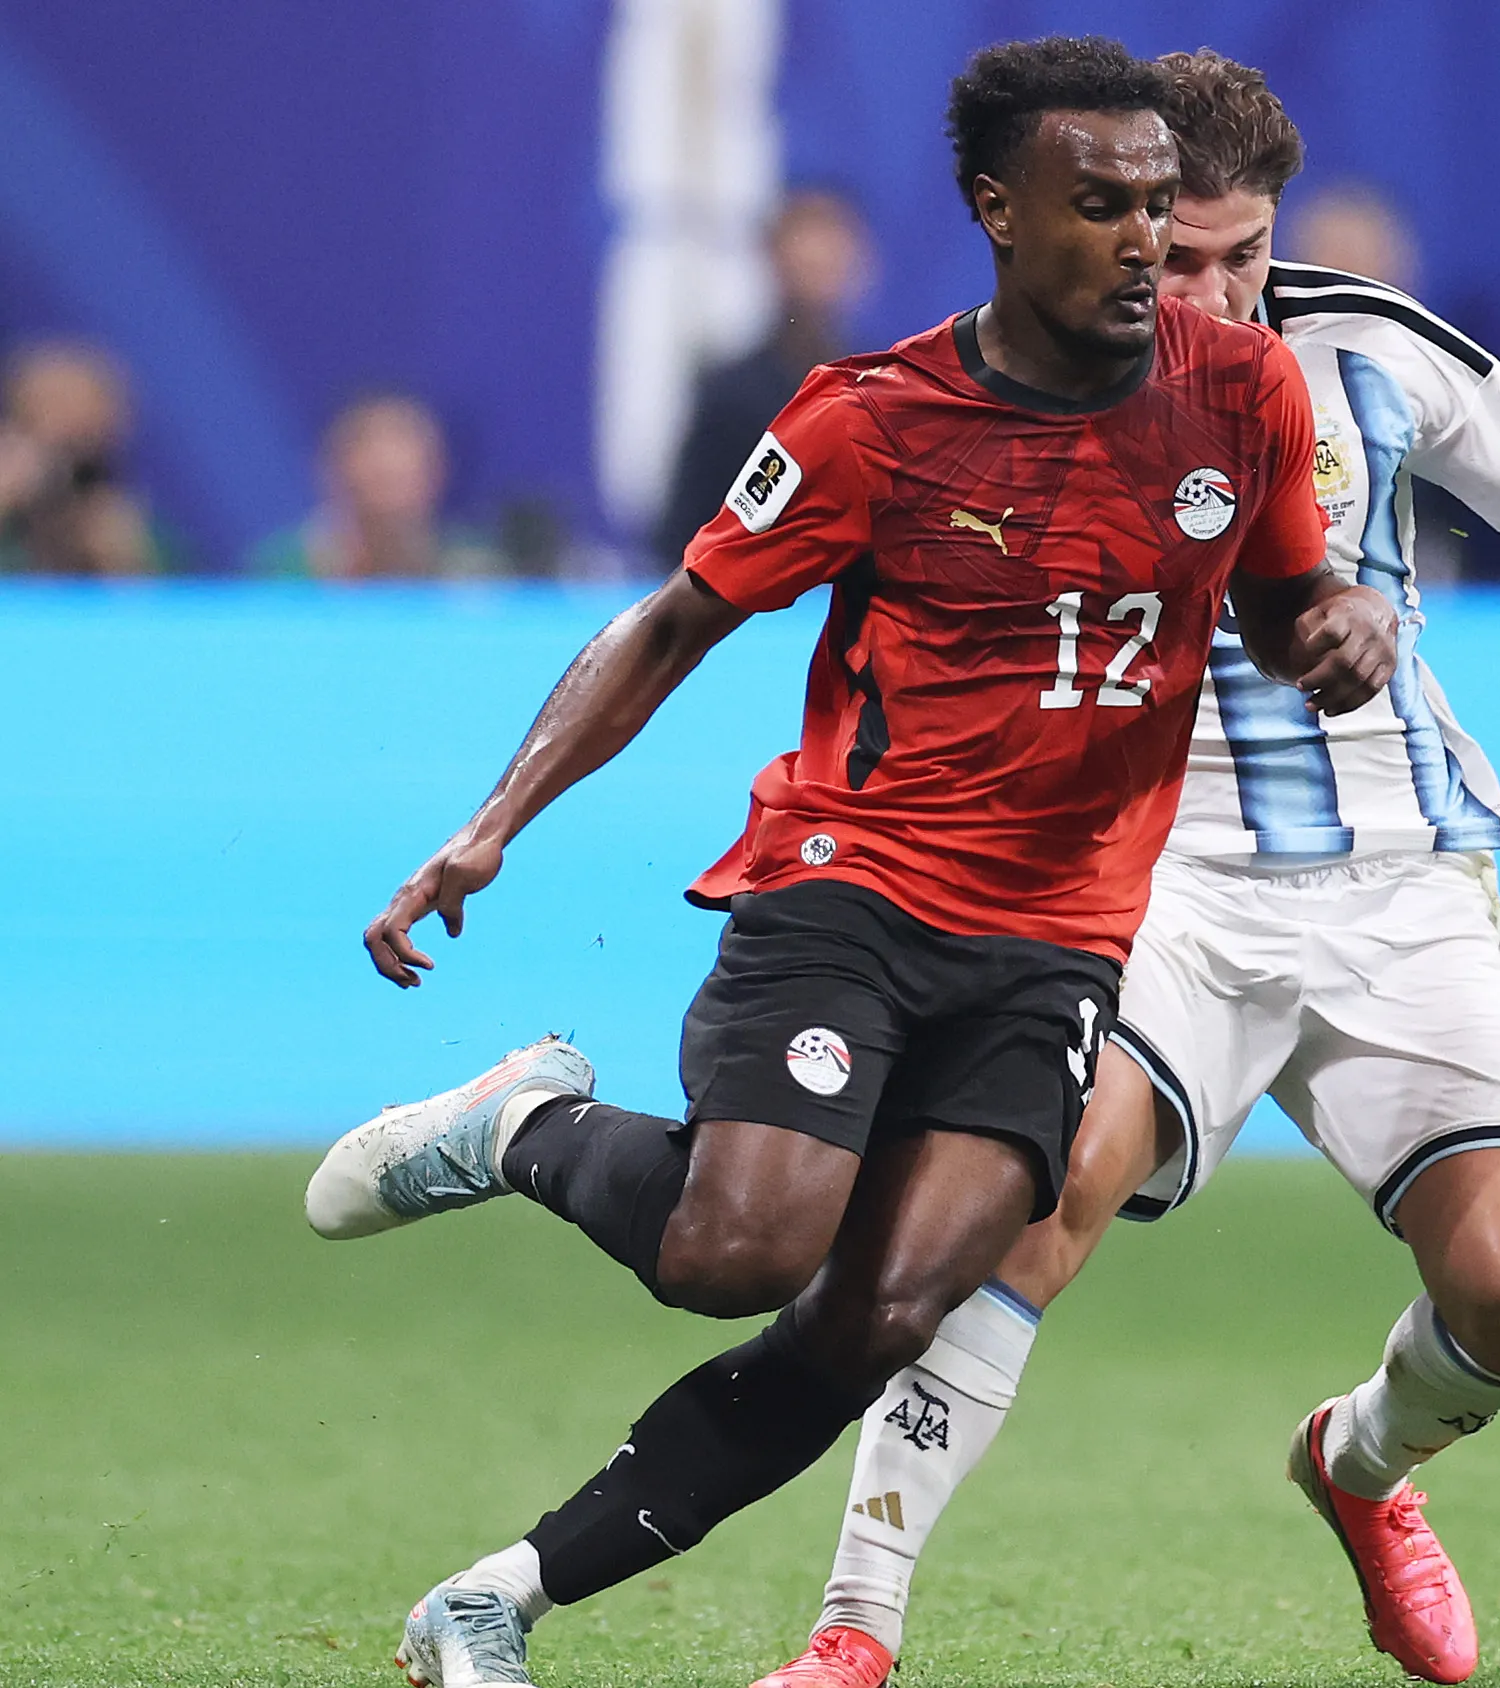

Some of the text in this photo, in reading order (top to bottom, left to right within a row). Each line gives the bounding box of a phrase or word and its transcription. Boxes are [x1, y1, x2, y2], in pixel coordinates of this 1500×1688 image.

[1314, 440, 1340, 475] FA
[1040, 591, 1163, 709] 12
[884, 1380, 951, 1451] AFA
